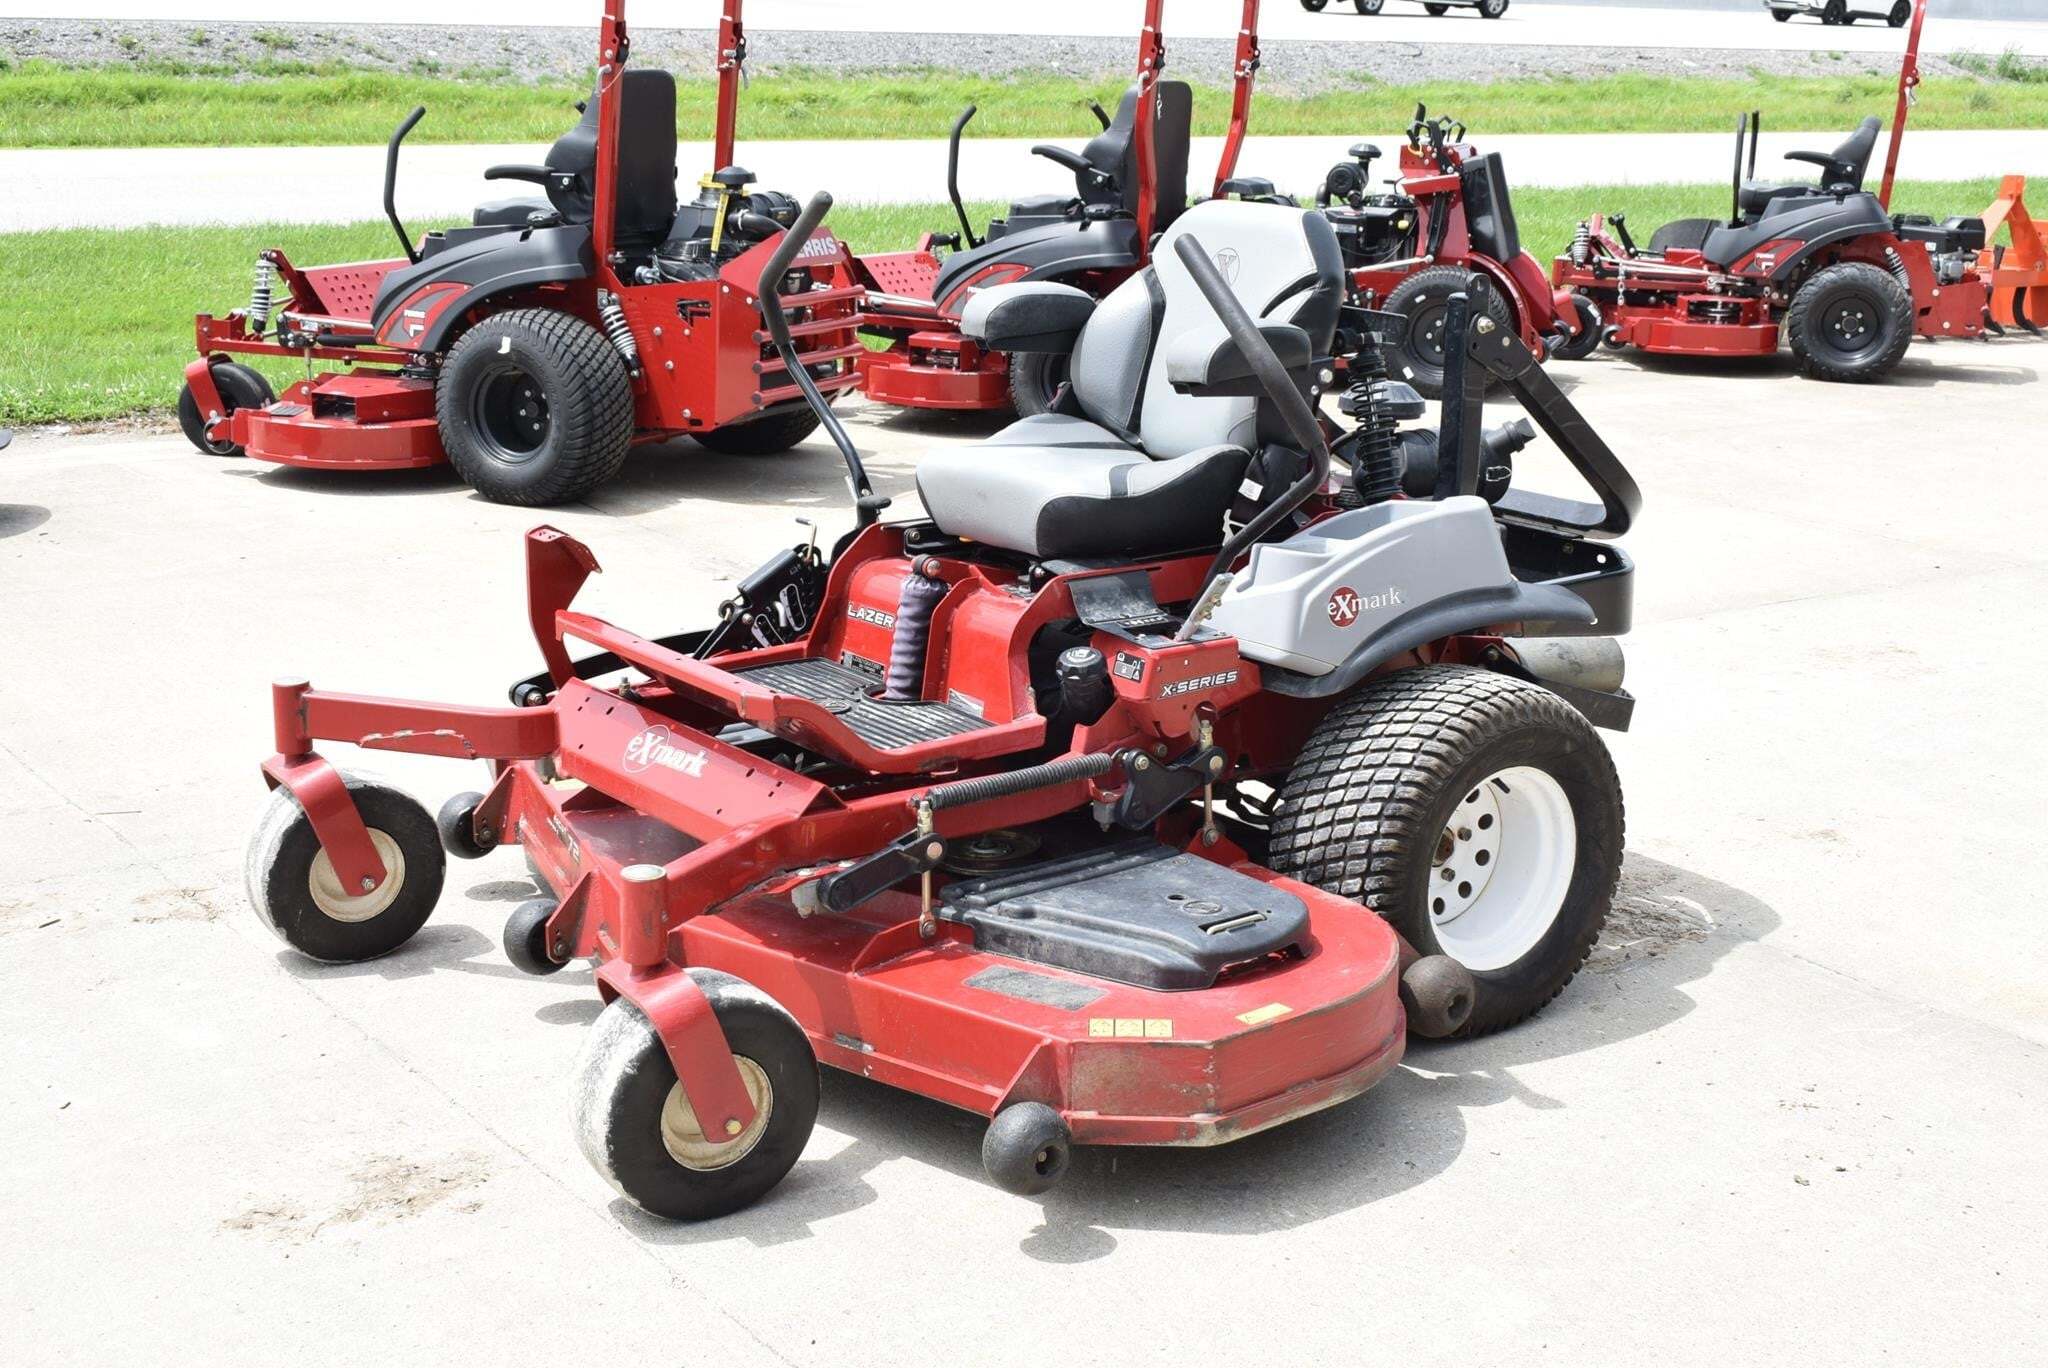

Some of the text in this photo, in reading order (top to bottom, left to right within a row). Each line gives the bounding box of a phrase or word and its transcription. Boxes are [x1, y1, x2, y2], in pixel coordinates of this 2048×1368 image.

[797, 236, 838, 257] RRIS
[847, 603, 894, 629] LAZER
[1327, 587, 1401, 622] eXmark
[1161, 670, 1238, 698] X-SERIES
[625, 731, 709, 778] eXmark
